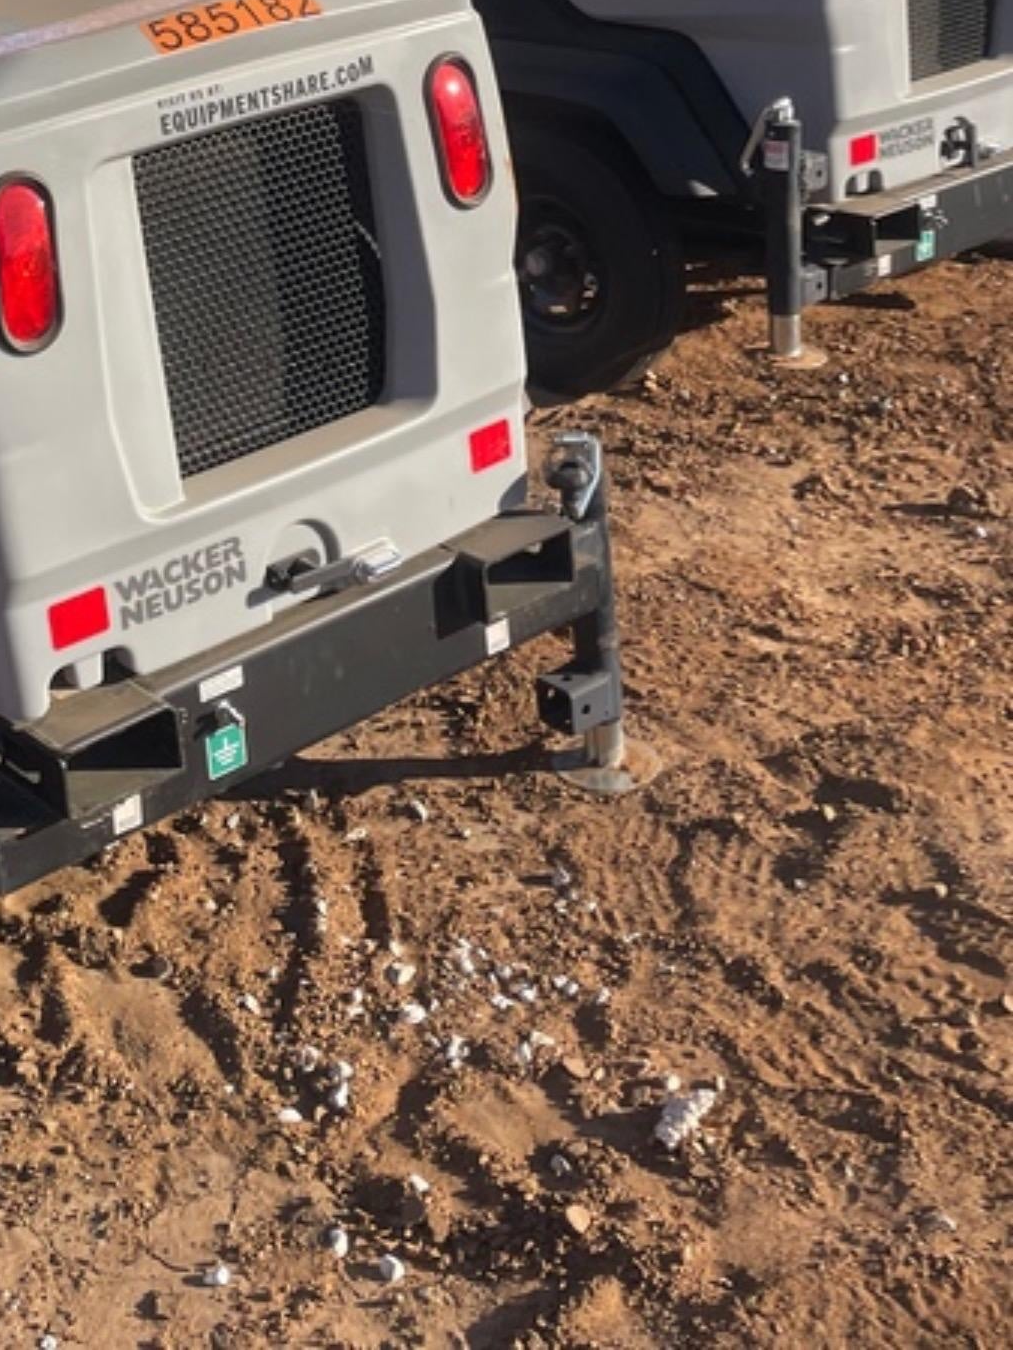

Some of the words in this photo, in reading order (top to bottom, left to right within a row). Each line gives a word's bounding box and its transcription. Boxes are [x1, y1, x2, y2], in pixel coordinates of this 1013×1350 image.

[159, 55, 375, 137] EQUIPMENTSHARE.COM
[113, 536, 244, 603] WACKER
[119, 561, 247, 631] NEUSON
